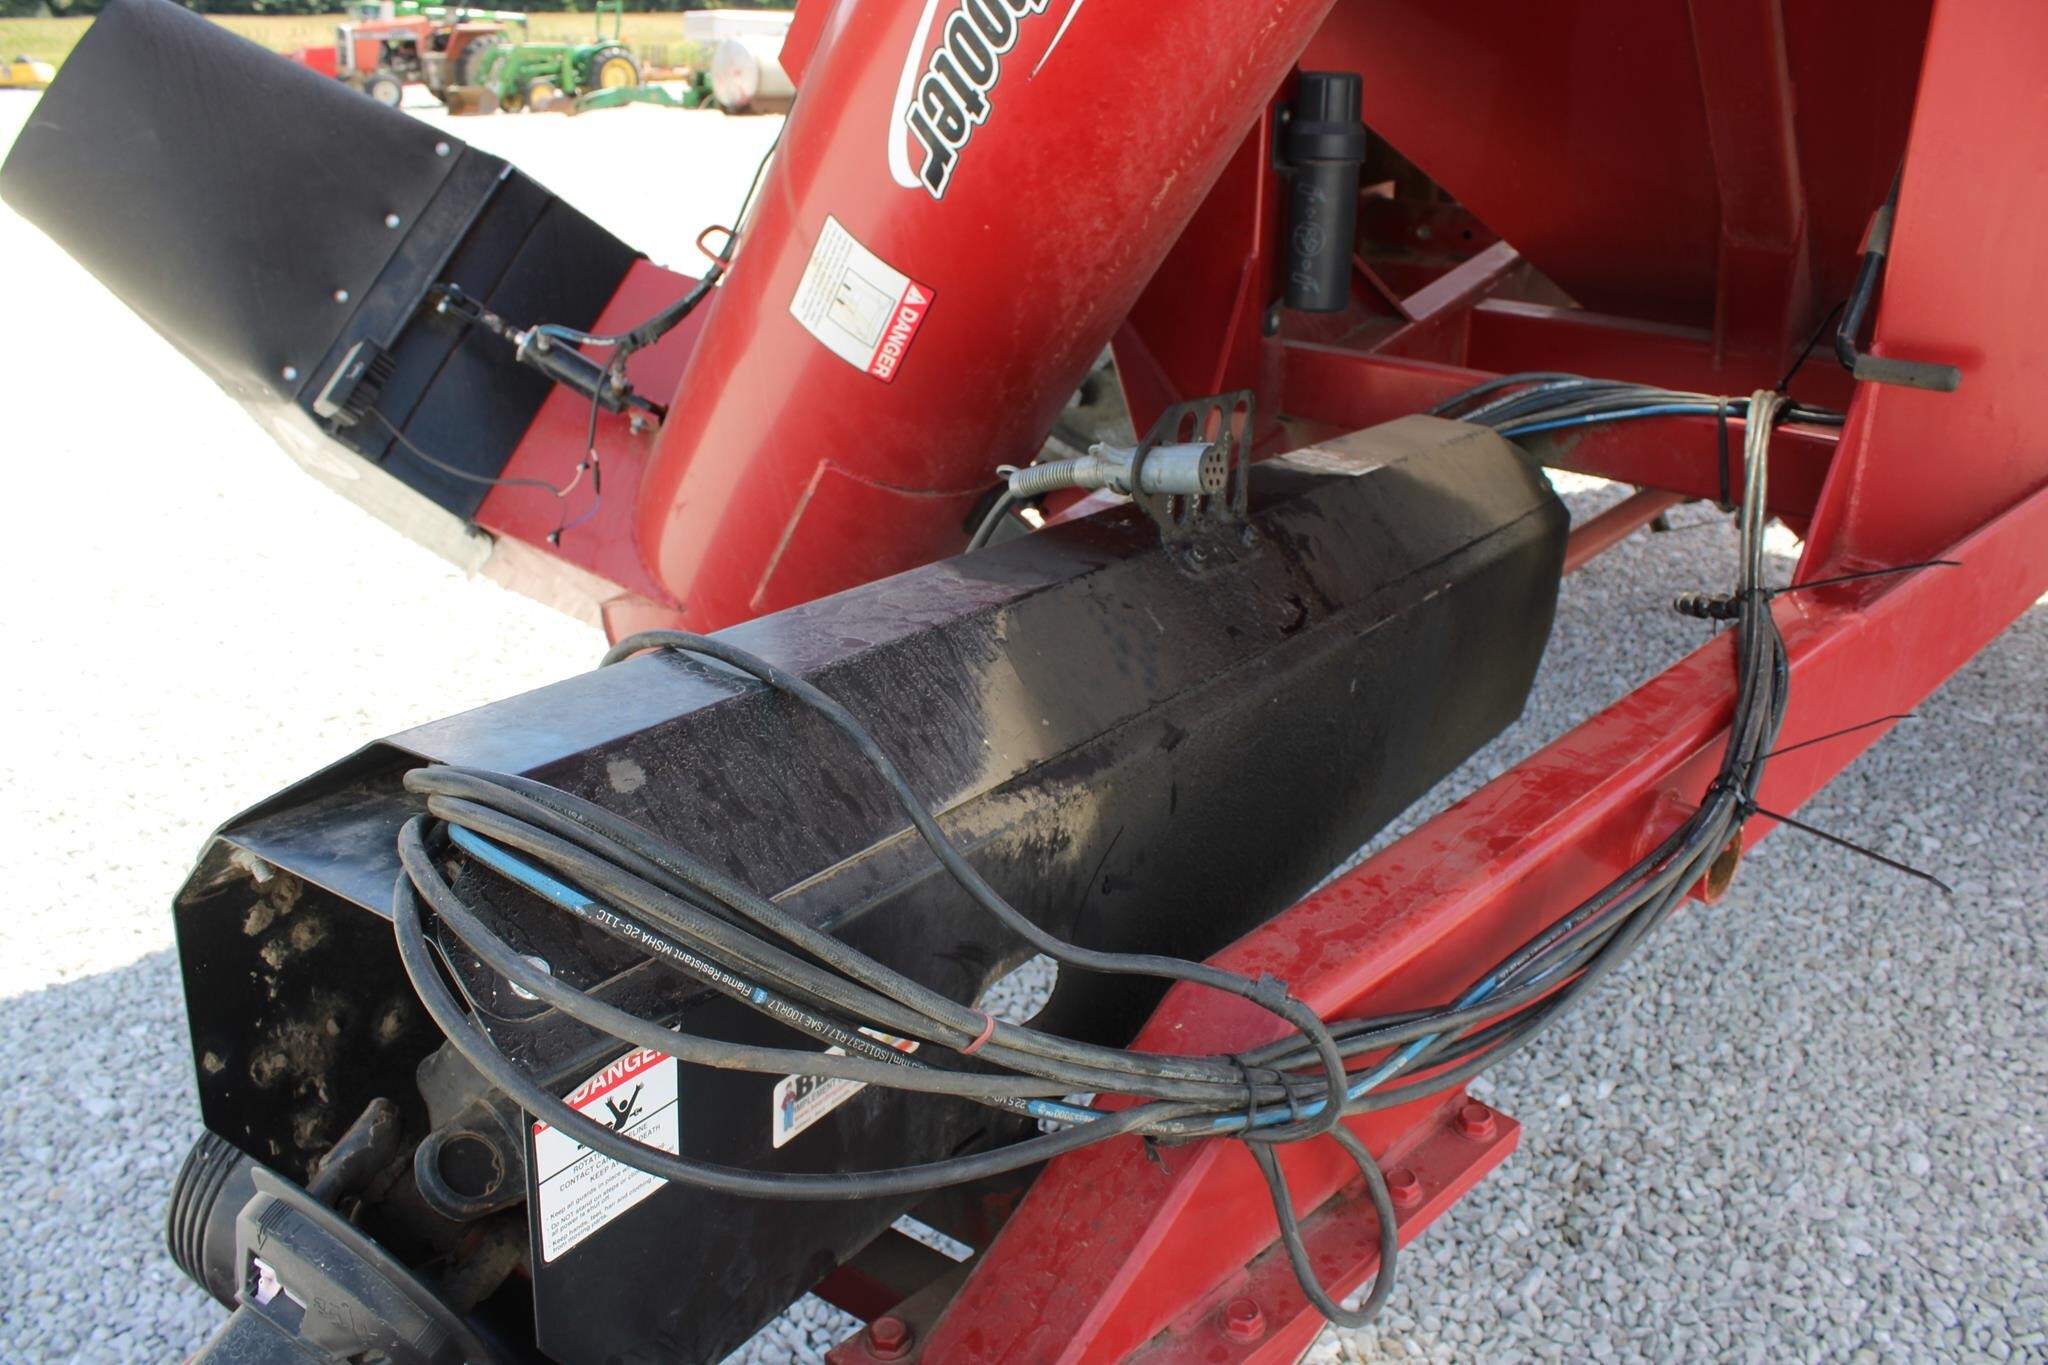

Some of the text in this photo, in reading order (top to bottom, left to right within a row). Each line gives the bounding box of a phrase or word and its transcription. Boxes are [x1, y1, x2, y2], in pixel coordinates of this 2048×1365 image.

[905, 0, 1049, 199] ooter
[872, 307, 920, 379] DANGER
[596, 909, 641, 940] 2G-11C
[641, 931, 673, 956] MSHA
[673, 948, 721, 981] Resistant
[722, 975, 752, 998] Flame
[767, 999, 805, 1023] 100R17
[805, 1017, 823, 1032] SAE
[828, 1027, 849, 1043] R17
[570, 1047, 662, 1105] DANGE
[559, 1164, 597, 1192] CONTACT
[638, 1124, 661, 1141] DEATH
[590, 1165, 609, 1182] KEEP
[550, 1206, 566, 1220] Keep
